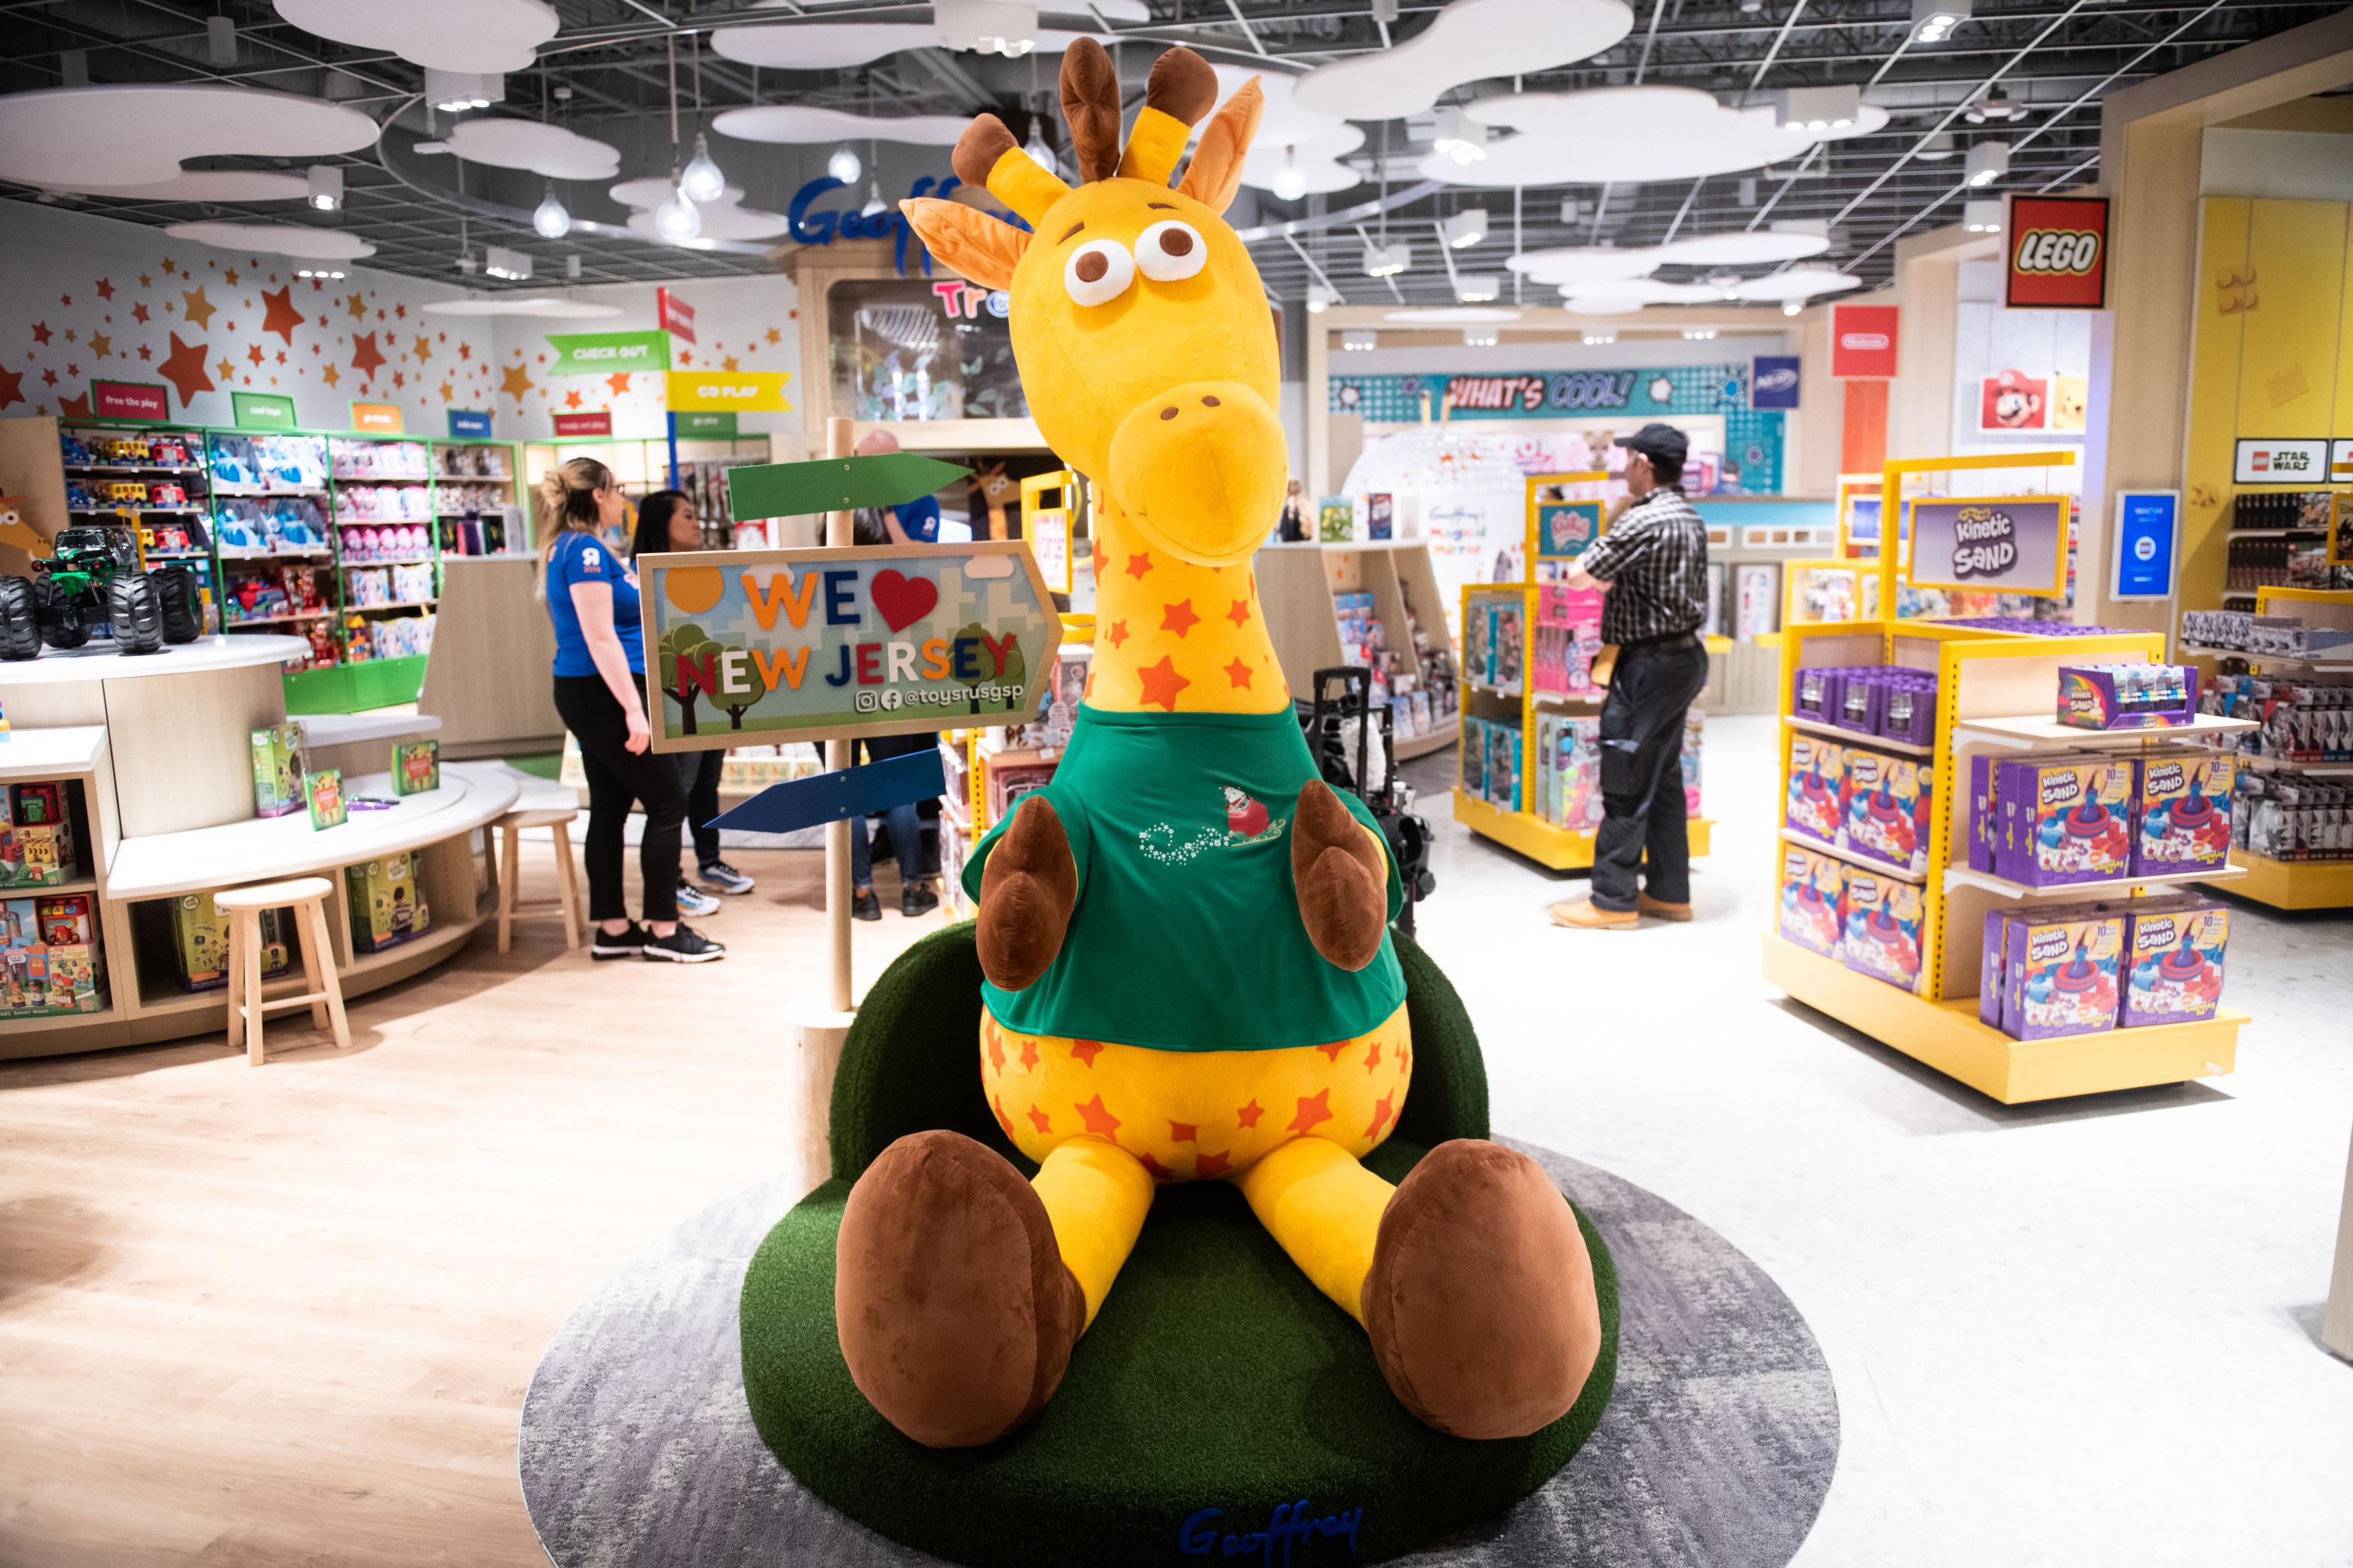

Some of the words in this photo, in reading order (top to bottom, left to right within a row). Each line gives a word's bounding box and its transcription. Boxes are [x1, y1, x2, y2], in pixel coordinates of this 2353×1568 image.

[788, 176, 1034, 277] Geoff
[2018, 232, 2097, 271] LEGO
[573, 348, 617, 360] CHECK
[619, 345, 649, 358] OUT
[697, 386, 719, 398] GO
[722, 385, 758, 397] PLAY
[1448, 375, 1545, 409] WHAT'S
[1548, 372, 1637, 409] COOL!
[2273, 452, 2310, 461] STAR
[2273, 461, 2310, 471] WARS
[740, 570, 862, 630] WE
[676, 646, 811, 697] NEW
[824, 633, 1018, 688] JERSEY
[904, 683, 1025, 709] @toysrusgsp
[2106, 769, 2116, 779] 10
[2211, 761, 2220, 773] 10
[2204, 916, 2213, 926] 10
[2097, 926, 2106, 936] 10
[1178, 1499, 1363, 1568] Geoffrey
